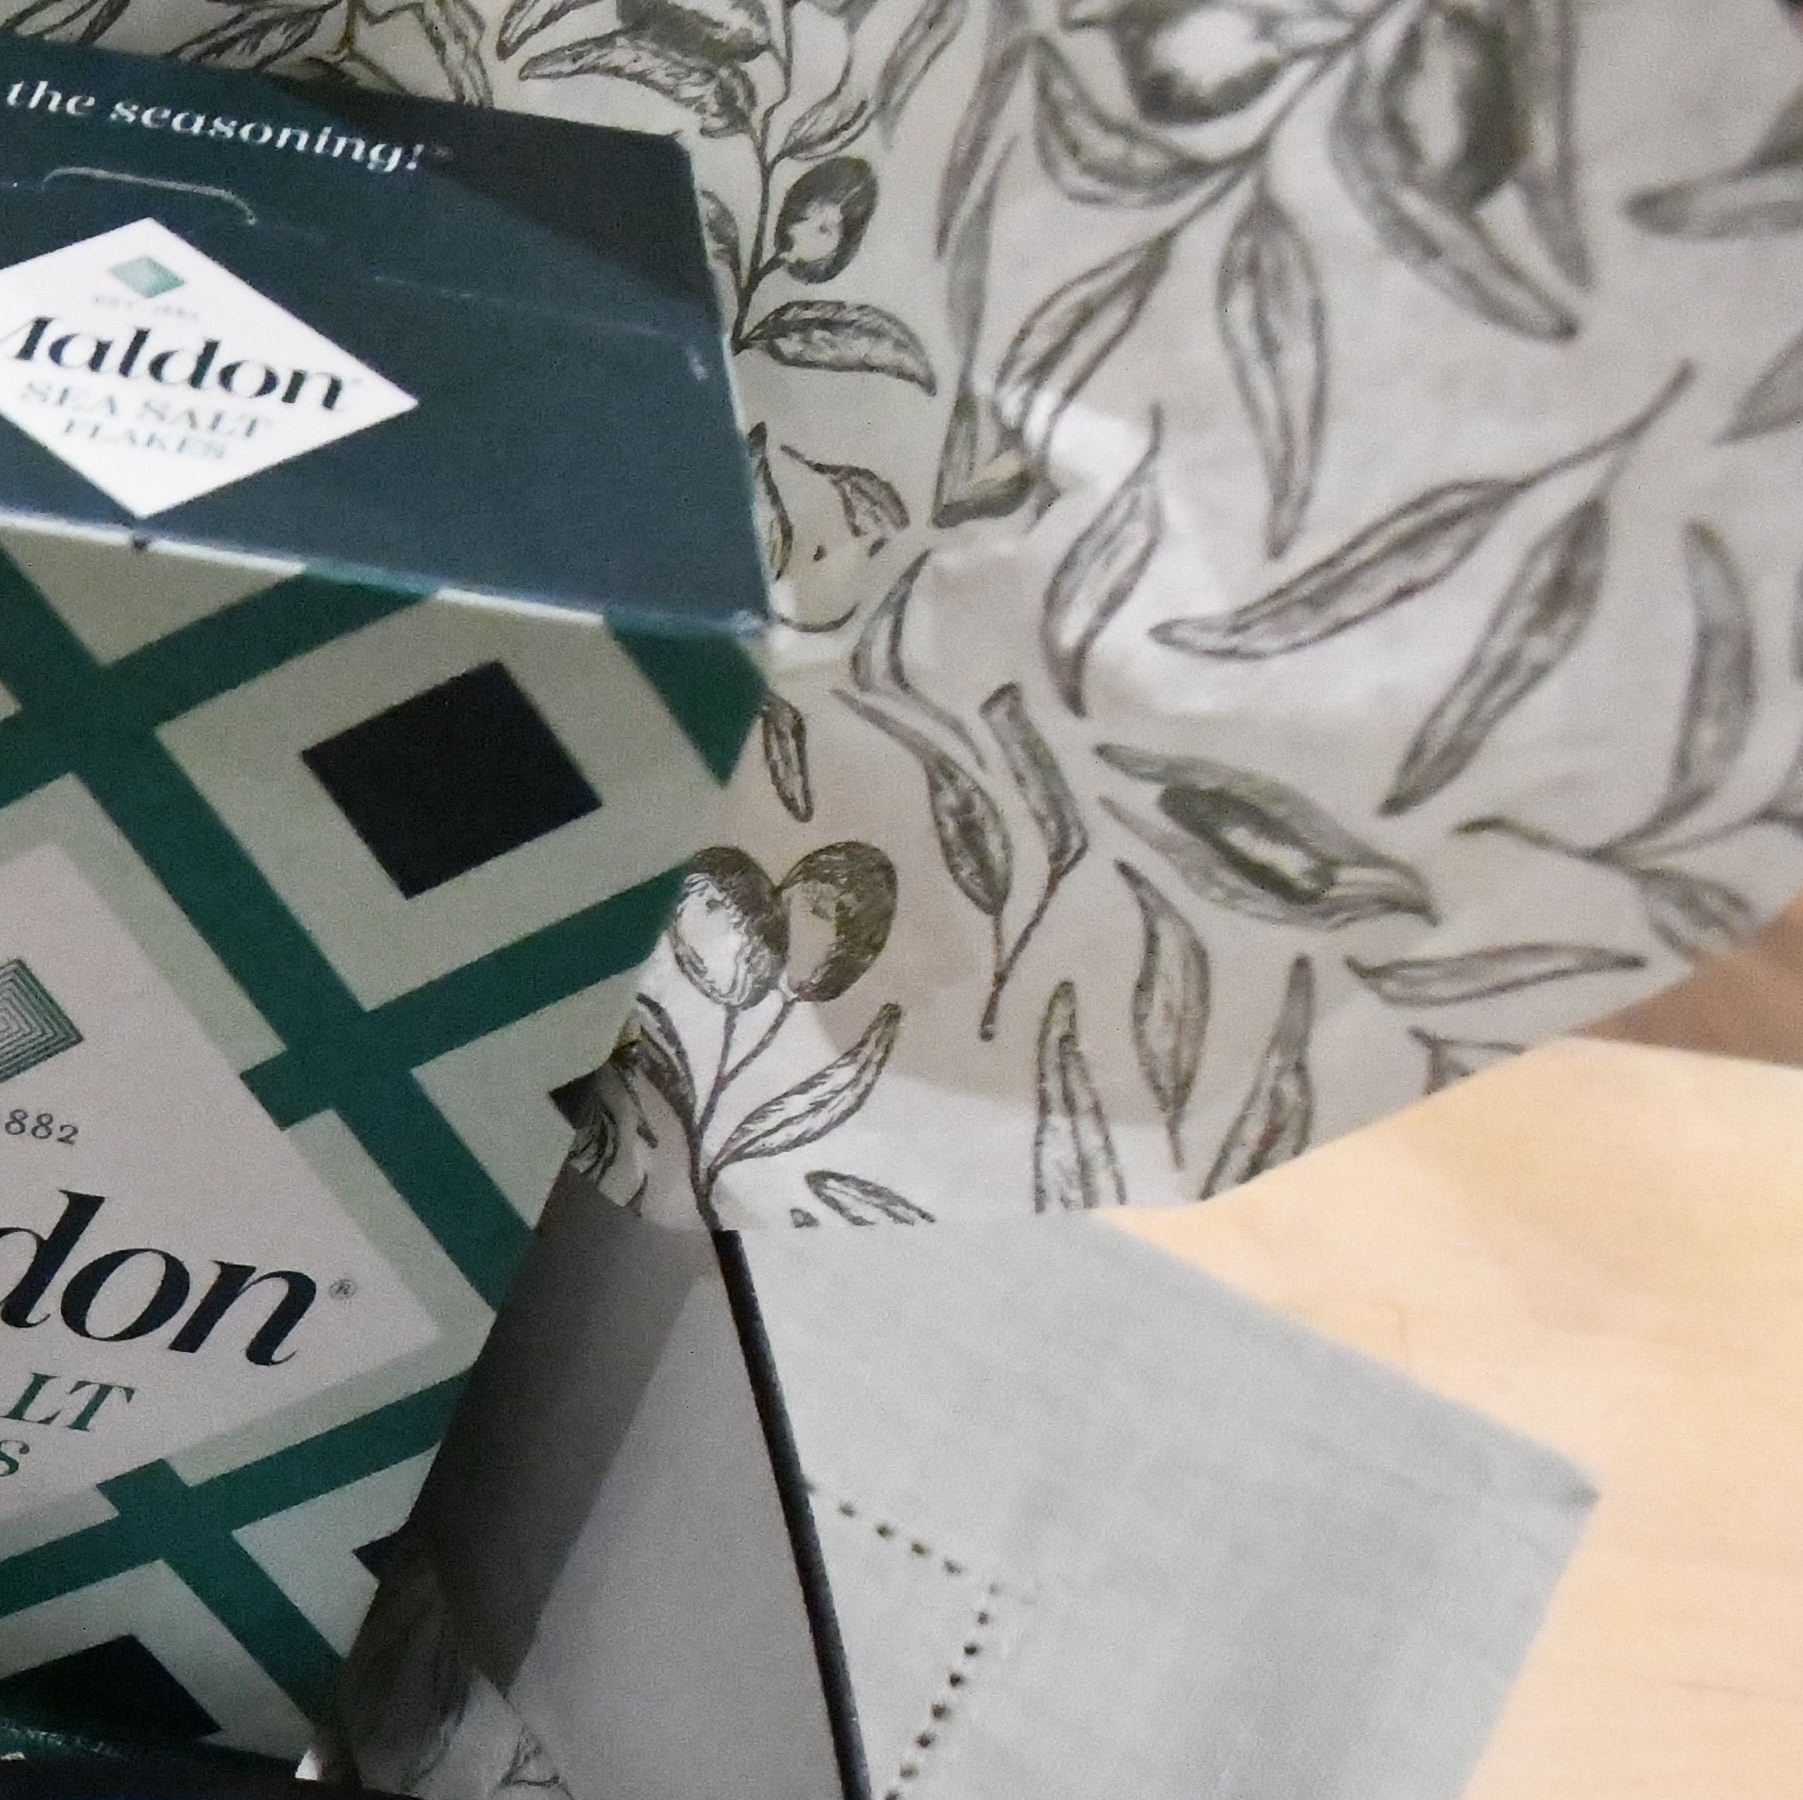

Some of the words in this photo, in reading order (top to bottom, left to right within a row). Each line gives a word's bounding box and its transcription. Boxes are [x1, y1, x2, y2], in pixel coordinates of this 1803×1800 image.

[6, 80, 95, 117] the
[21, 381, 119, 419] SEA
[136, 401, 271, 441] SALT
